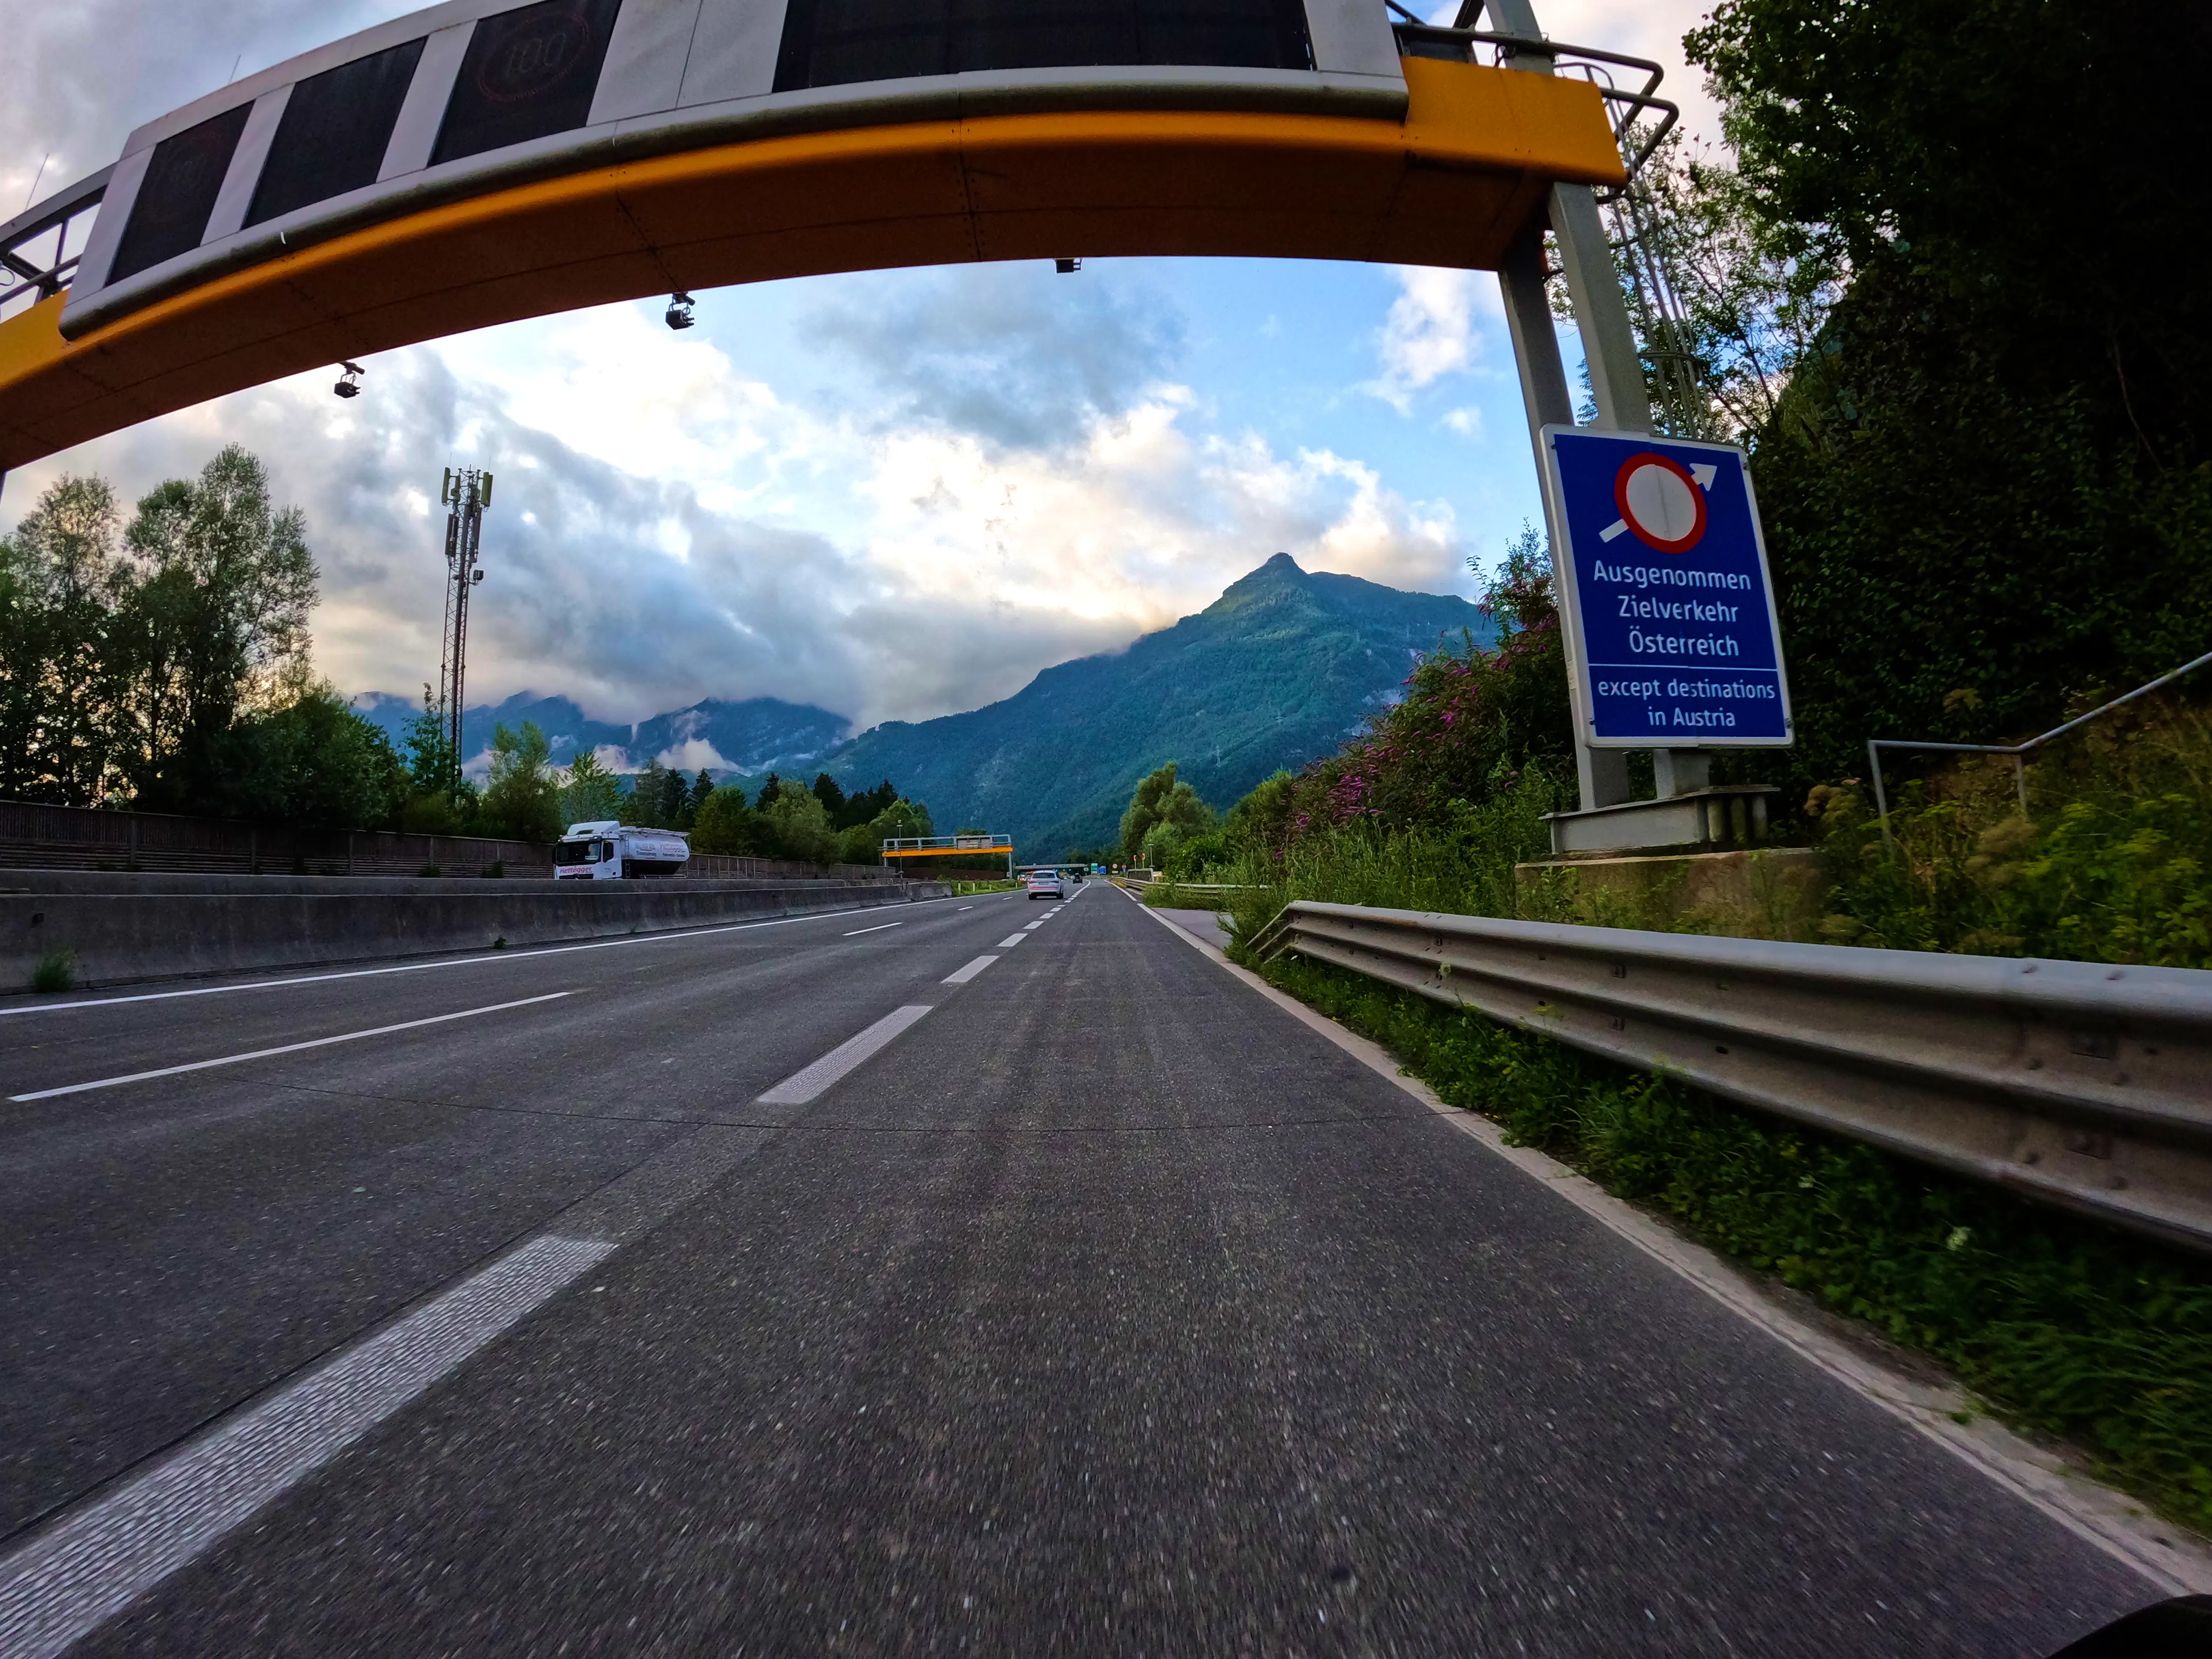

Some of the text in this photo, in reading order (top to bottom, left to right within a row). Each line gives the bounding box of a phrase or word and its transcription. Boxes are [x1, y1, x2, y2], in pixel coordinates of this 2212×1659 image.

[1594, 560, 1751, 590] Ausgenommen
[1618, 595, 1738, 622] Zielverkehr
[1629, 625, 1739, 656] Österreich
[1598, 679, 1775, 700] except destinations
[1648, 706, 1736, 726] in Austria
